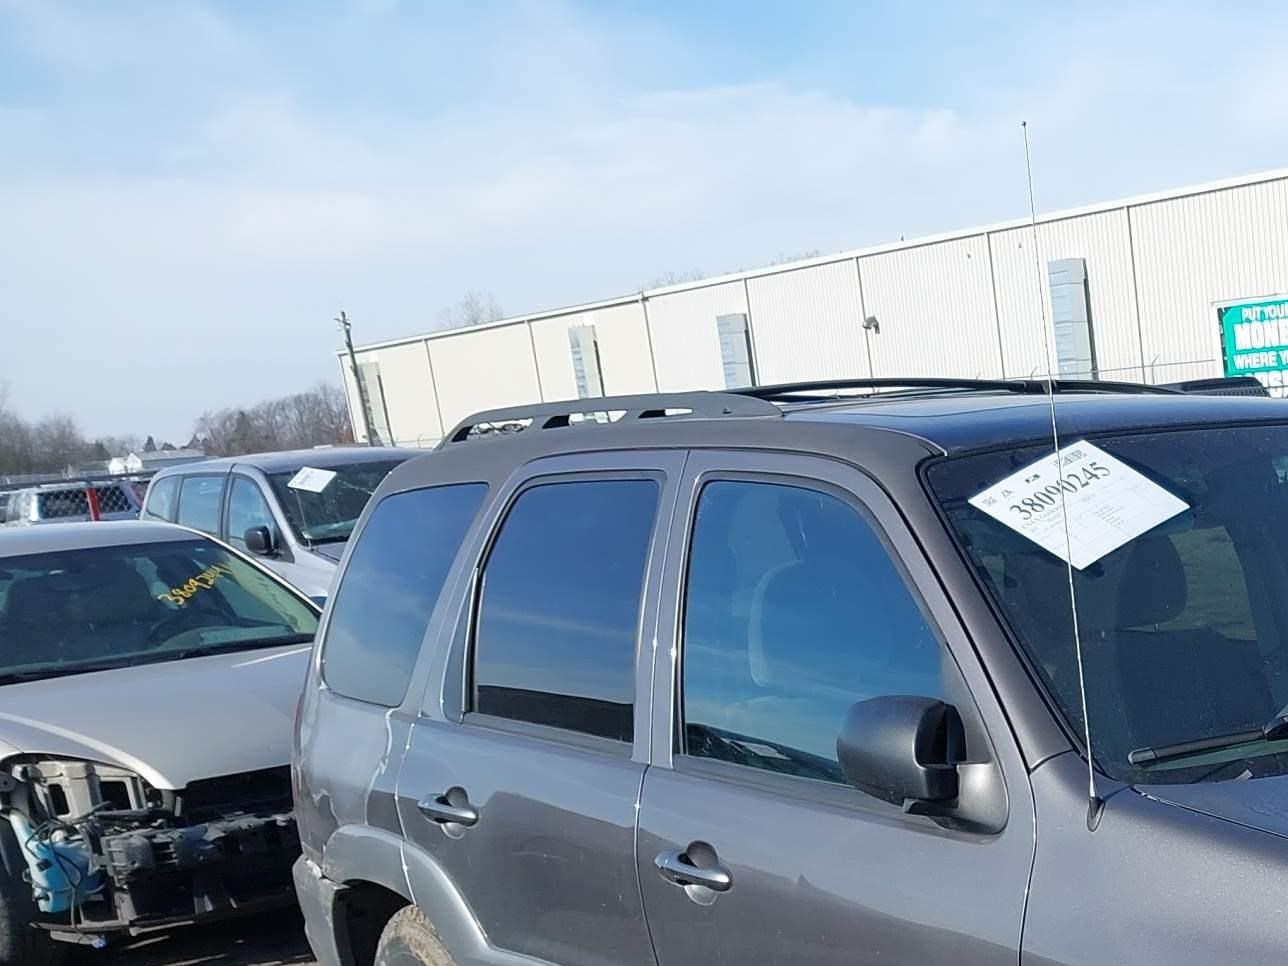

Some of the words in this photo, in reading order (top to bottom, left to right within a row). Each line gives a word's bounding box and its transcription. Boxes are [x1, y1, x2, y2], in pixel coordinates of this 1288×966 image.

[1242, 305, 1262, 322] PUT
[1233, 350, 1279, 370] WHERE
[1009, 462, 1111, 521] 38090245
